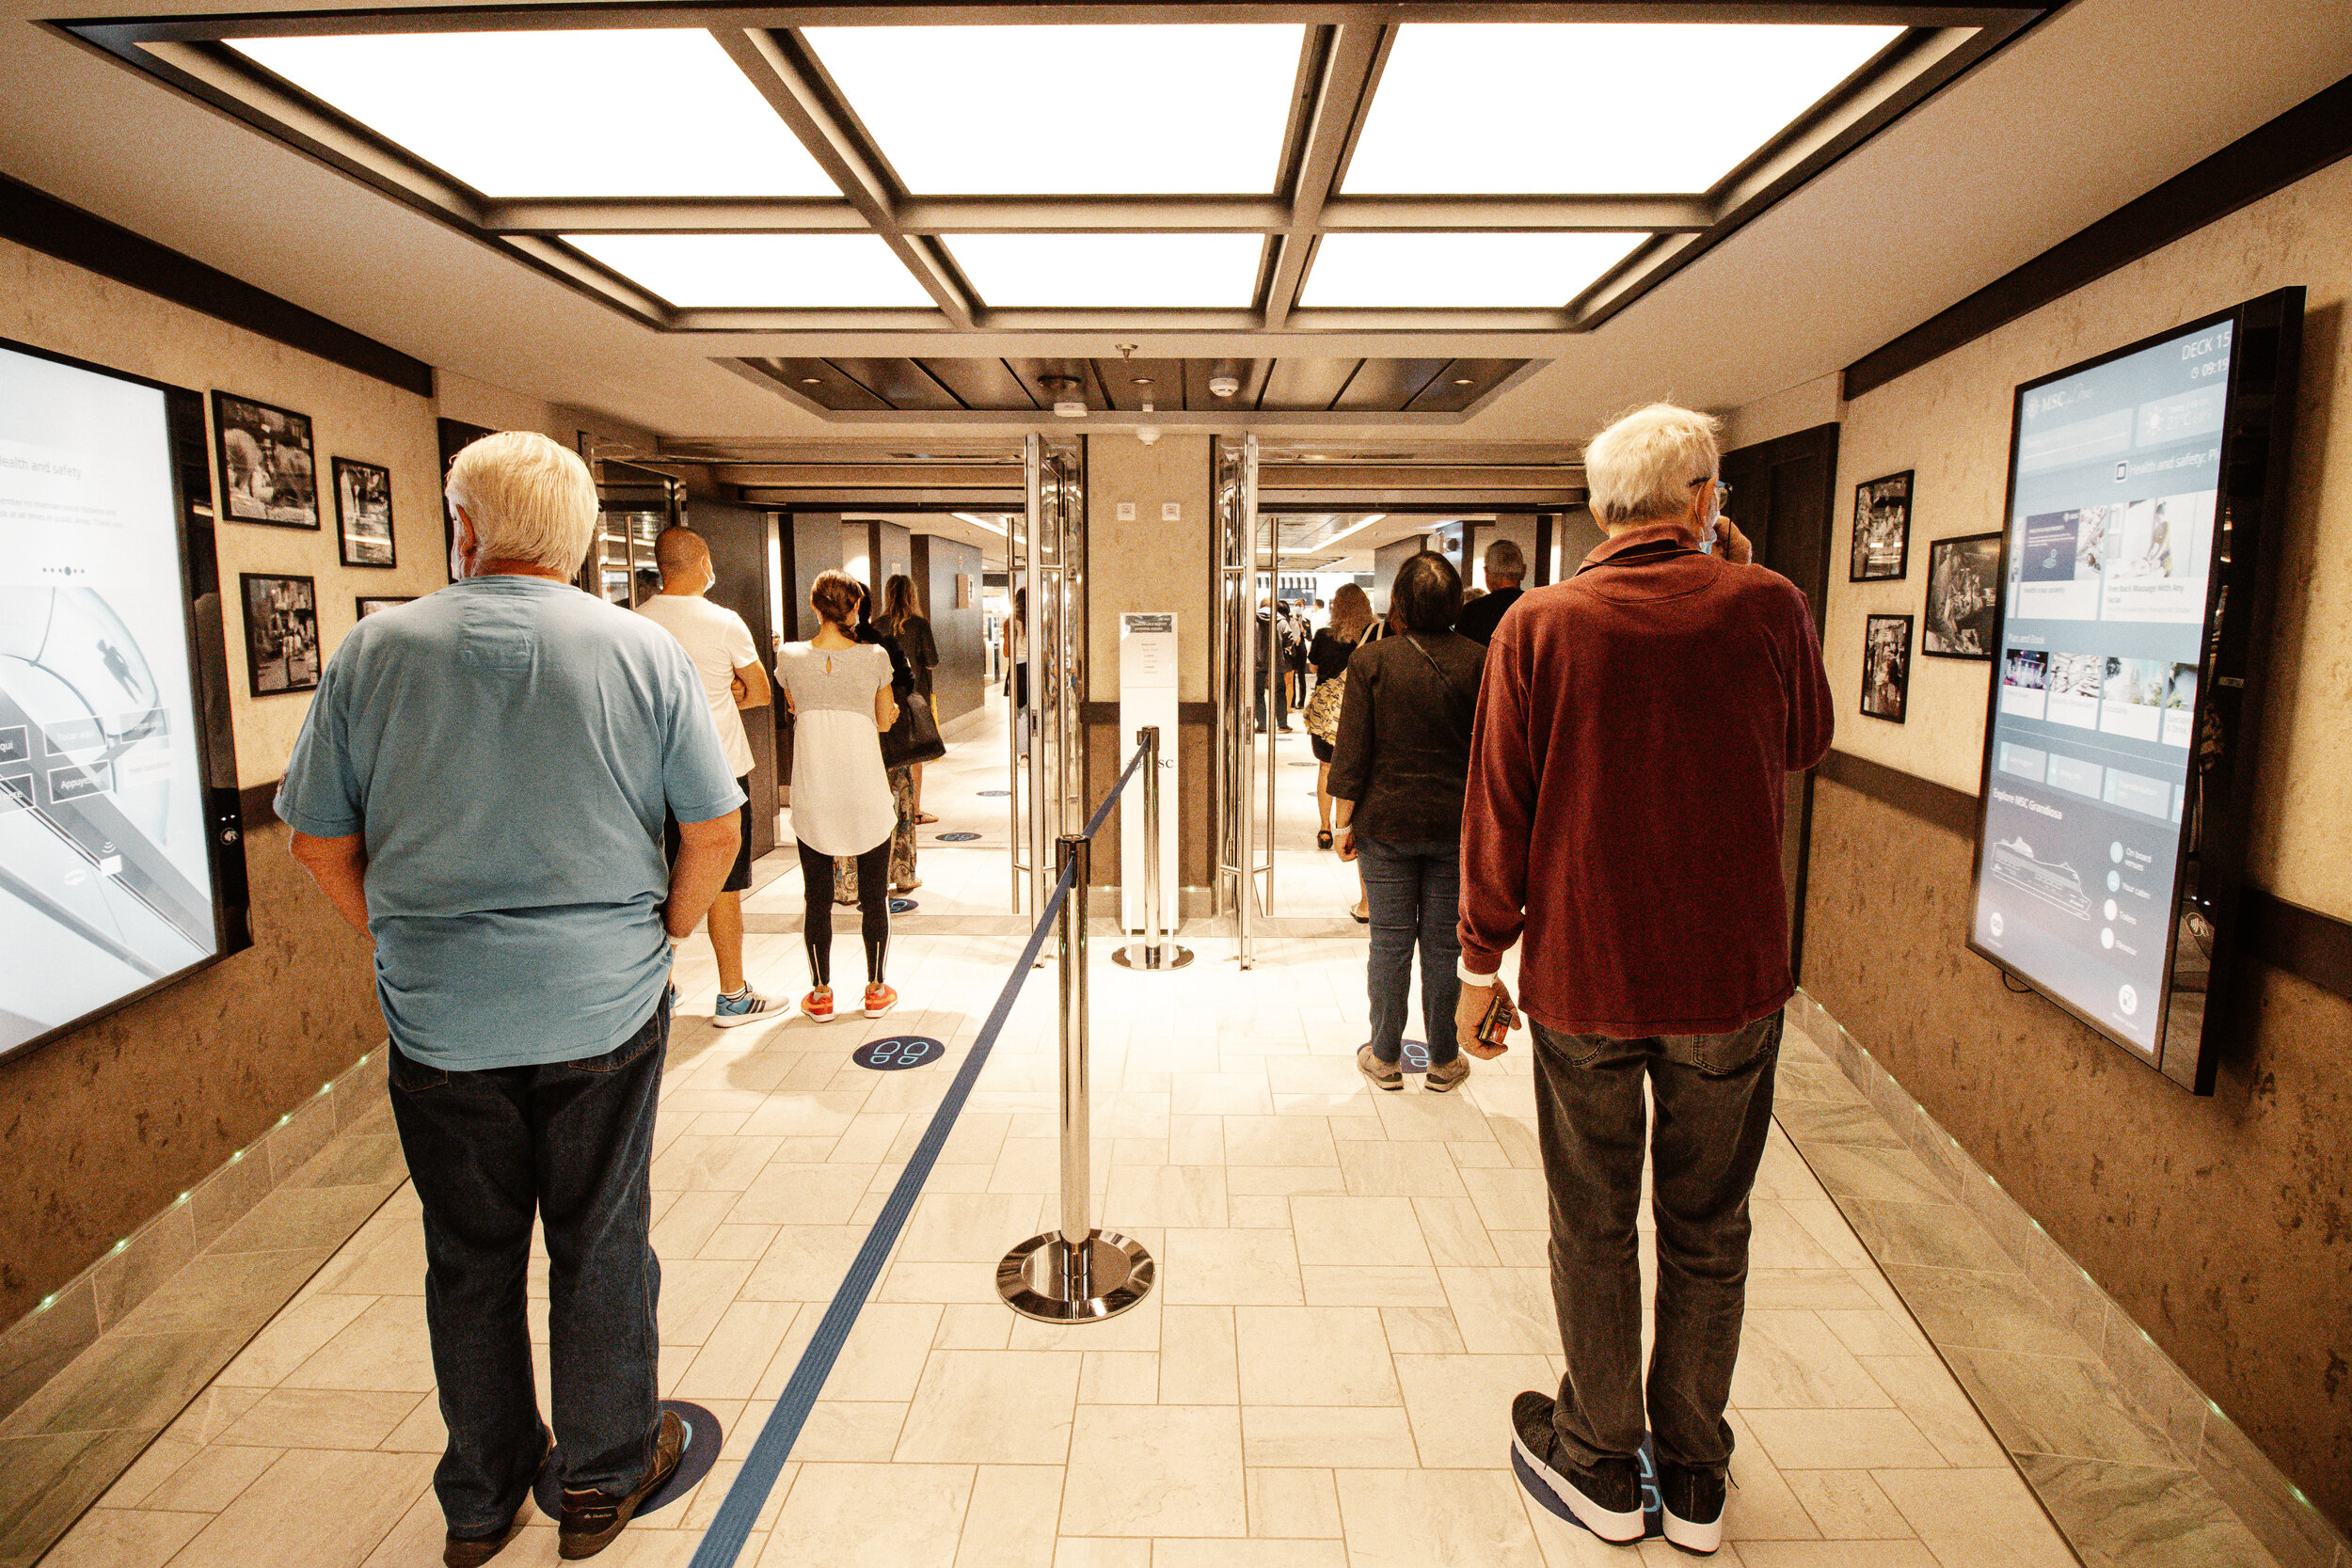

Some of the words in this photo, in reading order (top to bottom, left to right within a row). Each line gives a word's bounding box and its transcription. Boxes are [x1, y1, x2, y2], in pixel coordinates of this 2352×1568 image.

[2182, 337, 2214, 360] DECK
[2217, 330, 2231, 349] 15
[2201, 357, 2229, 376] 09:19
[2041, 390, 2066, 413] MSC
[31, 461, 50, 473] and
[52, 465, 82, 481] safety
[2014, 795, 2029, 809] MSC
[2028, 800, 2063, 820] Grandiosa
